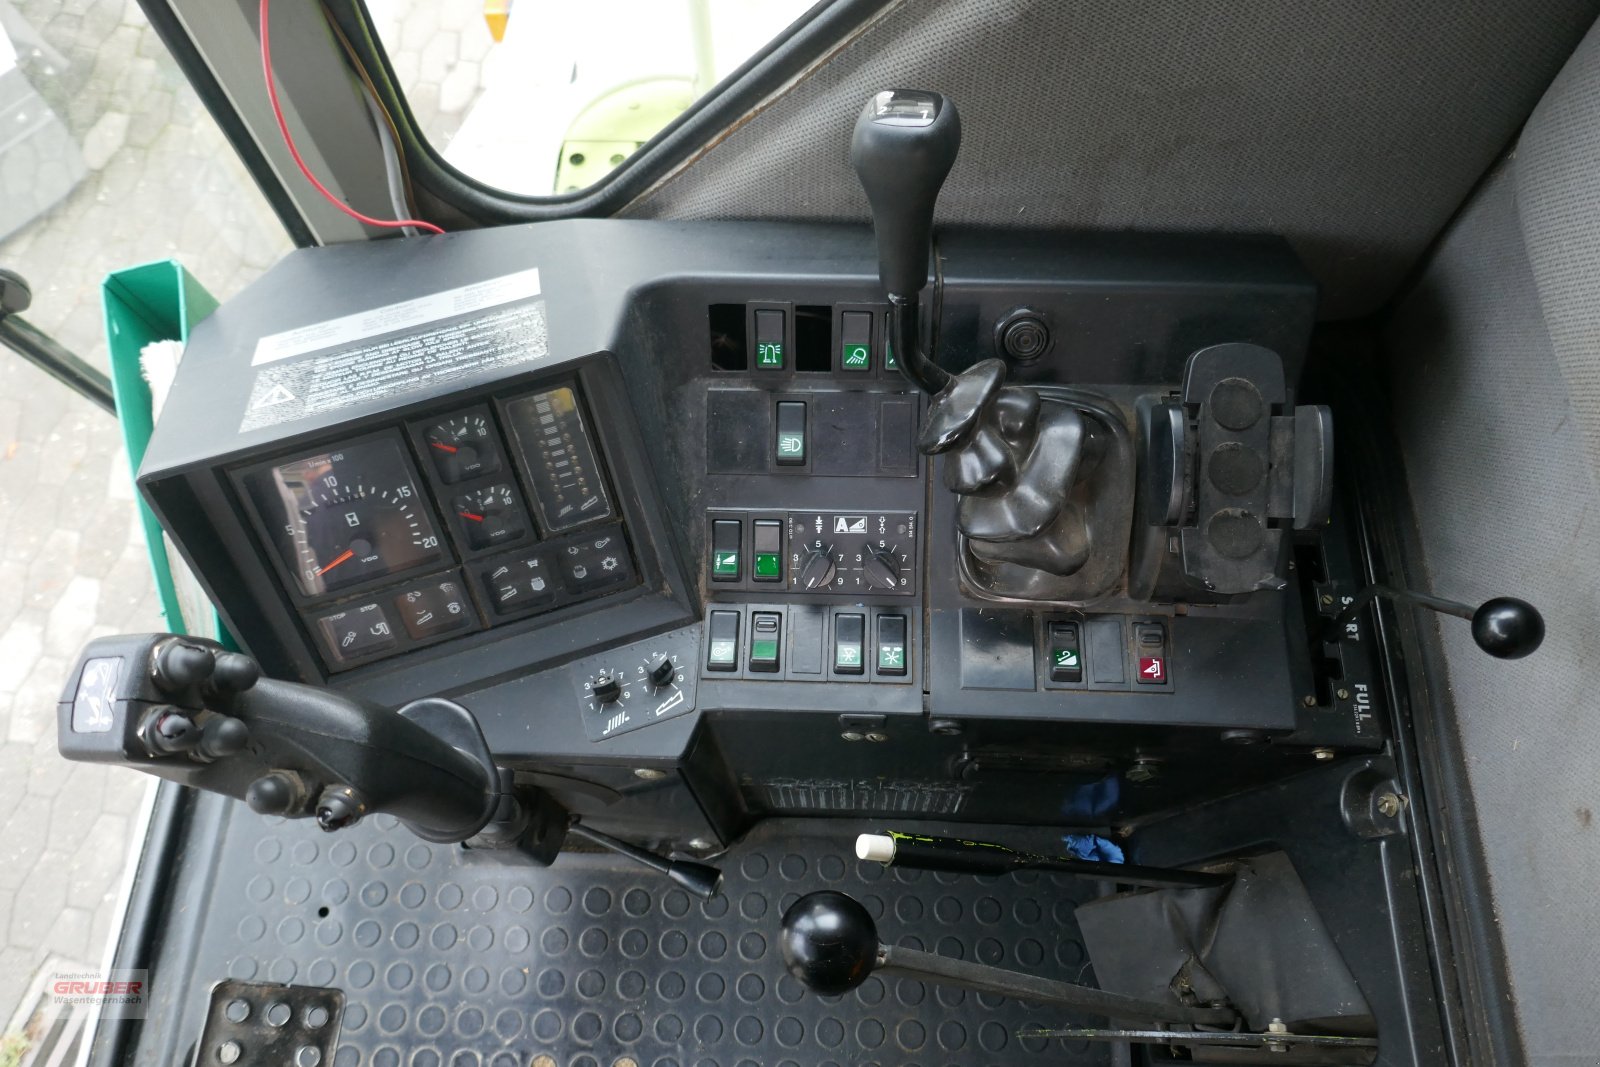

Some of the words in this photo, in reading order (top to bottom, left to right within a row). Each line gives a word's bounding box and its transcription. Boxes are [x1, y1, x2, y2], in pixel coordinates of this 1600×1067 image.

[477, 428, 487, 436] 10
[332, 454, 344, 462] 100
[323, 476, 338, 488] 10
[396, 486, 412, 498] 15
[503, 497, 512, 506] 10
[285, 524, 295, 536] 5
[422, 536, 438, 548] 20
[305, 570, 314, 580] 0
[360, 604, 377, 612] STOP
[1342, 596, 1359, 640] SRT
[1354, 684, 1372, 720] FULL
